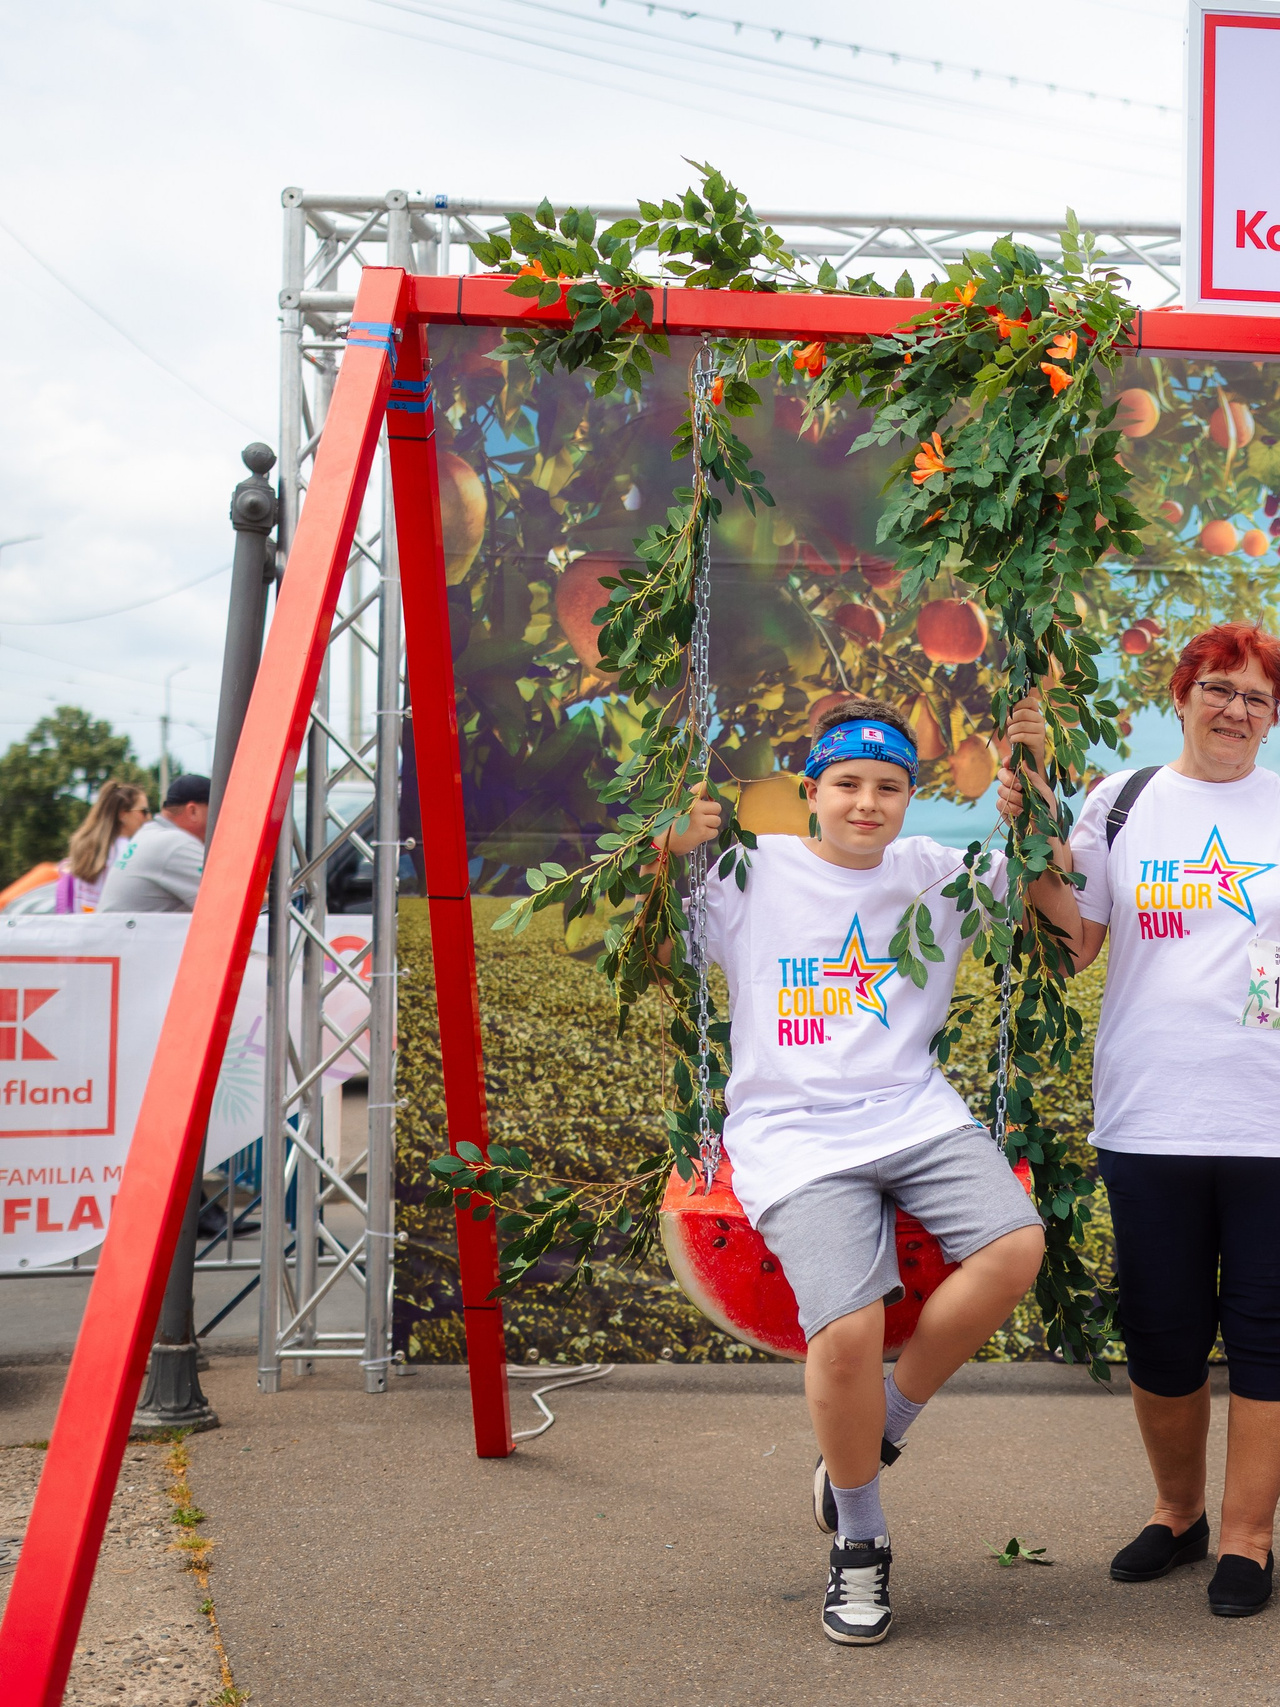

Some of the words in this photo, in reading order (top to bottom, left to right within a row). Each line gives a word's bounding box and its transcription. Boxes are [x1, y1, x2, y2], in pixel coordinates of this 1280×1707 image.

[1139, 859, 1180, 882] THE
[1135, 883, 1213, 910] COLOR
[778, 958, 819, 987] THE
[778, 987, 853, 1017] COLOR
[0, 1079, 93, 1105] fland
[3, 1195, 117, 1234] FLA
